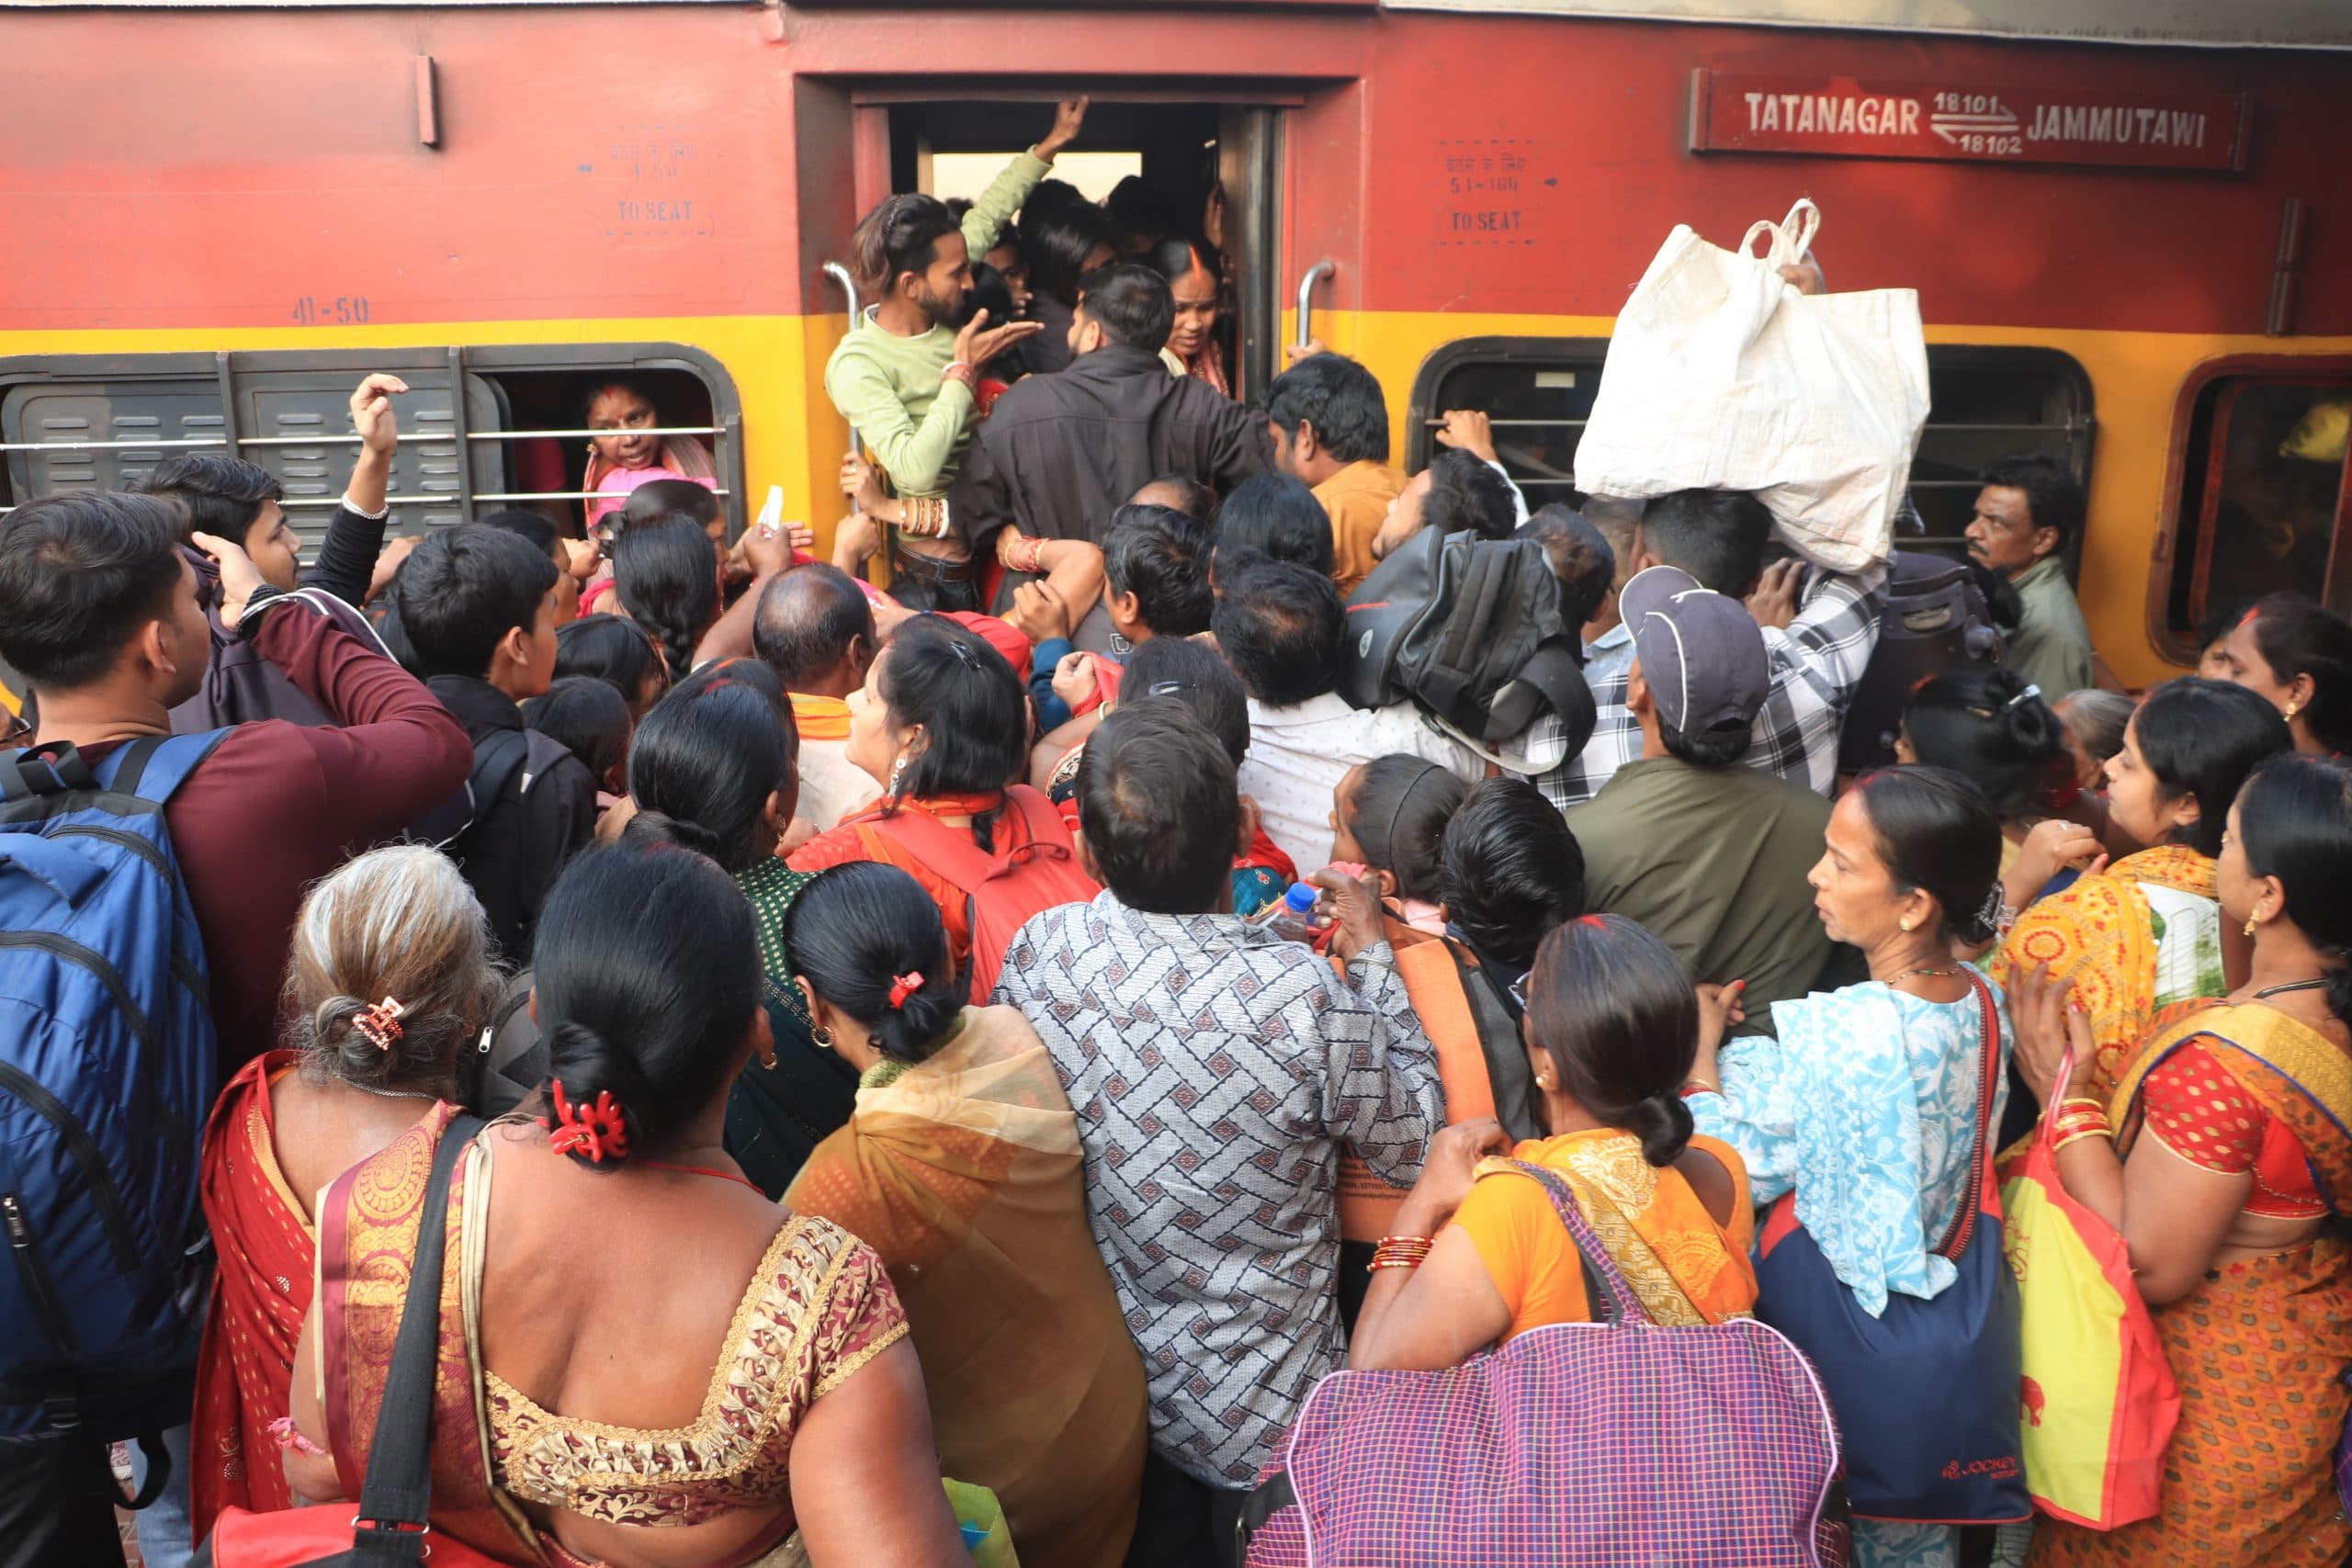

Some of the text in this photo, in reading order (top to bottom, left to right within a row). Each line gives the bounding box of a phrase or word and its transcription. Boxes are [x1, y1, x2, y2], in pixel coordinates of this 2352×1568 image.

[1933, 92, 1998, 114] 18101
[1745, 93, 1920, 135] TATANAGAR
[2026, 105, 2205, 148] JAMMUTAWI
[1959, 134, 2022, 154] 18102
[617, 201, 692, 220] TO SEAT
[1452, 211, 1521, 230] TO SEAT
[292, 296, 369, 324] 41-50
[1962, 1455, 2017, 1475] JOCKEY
